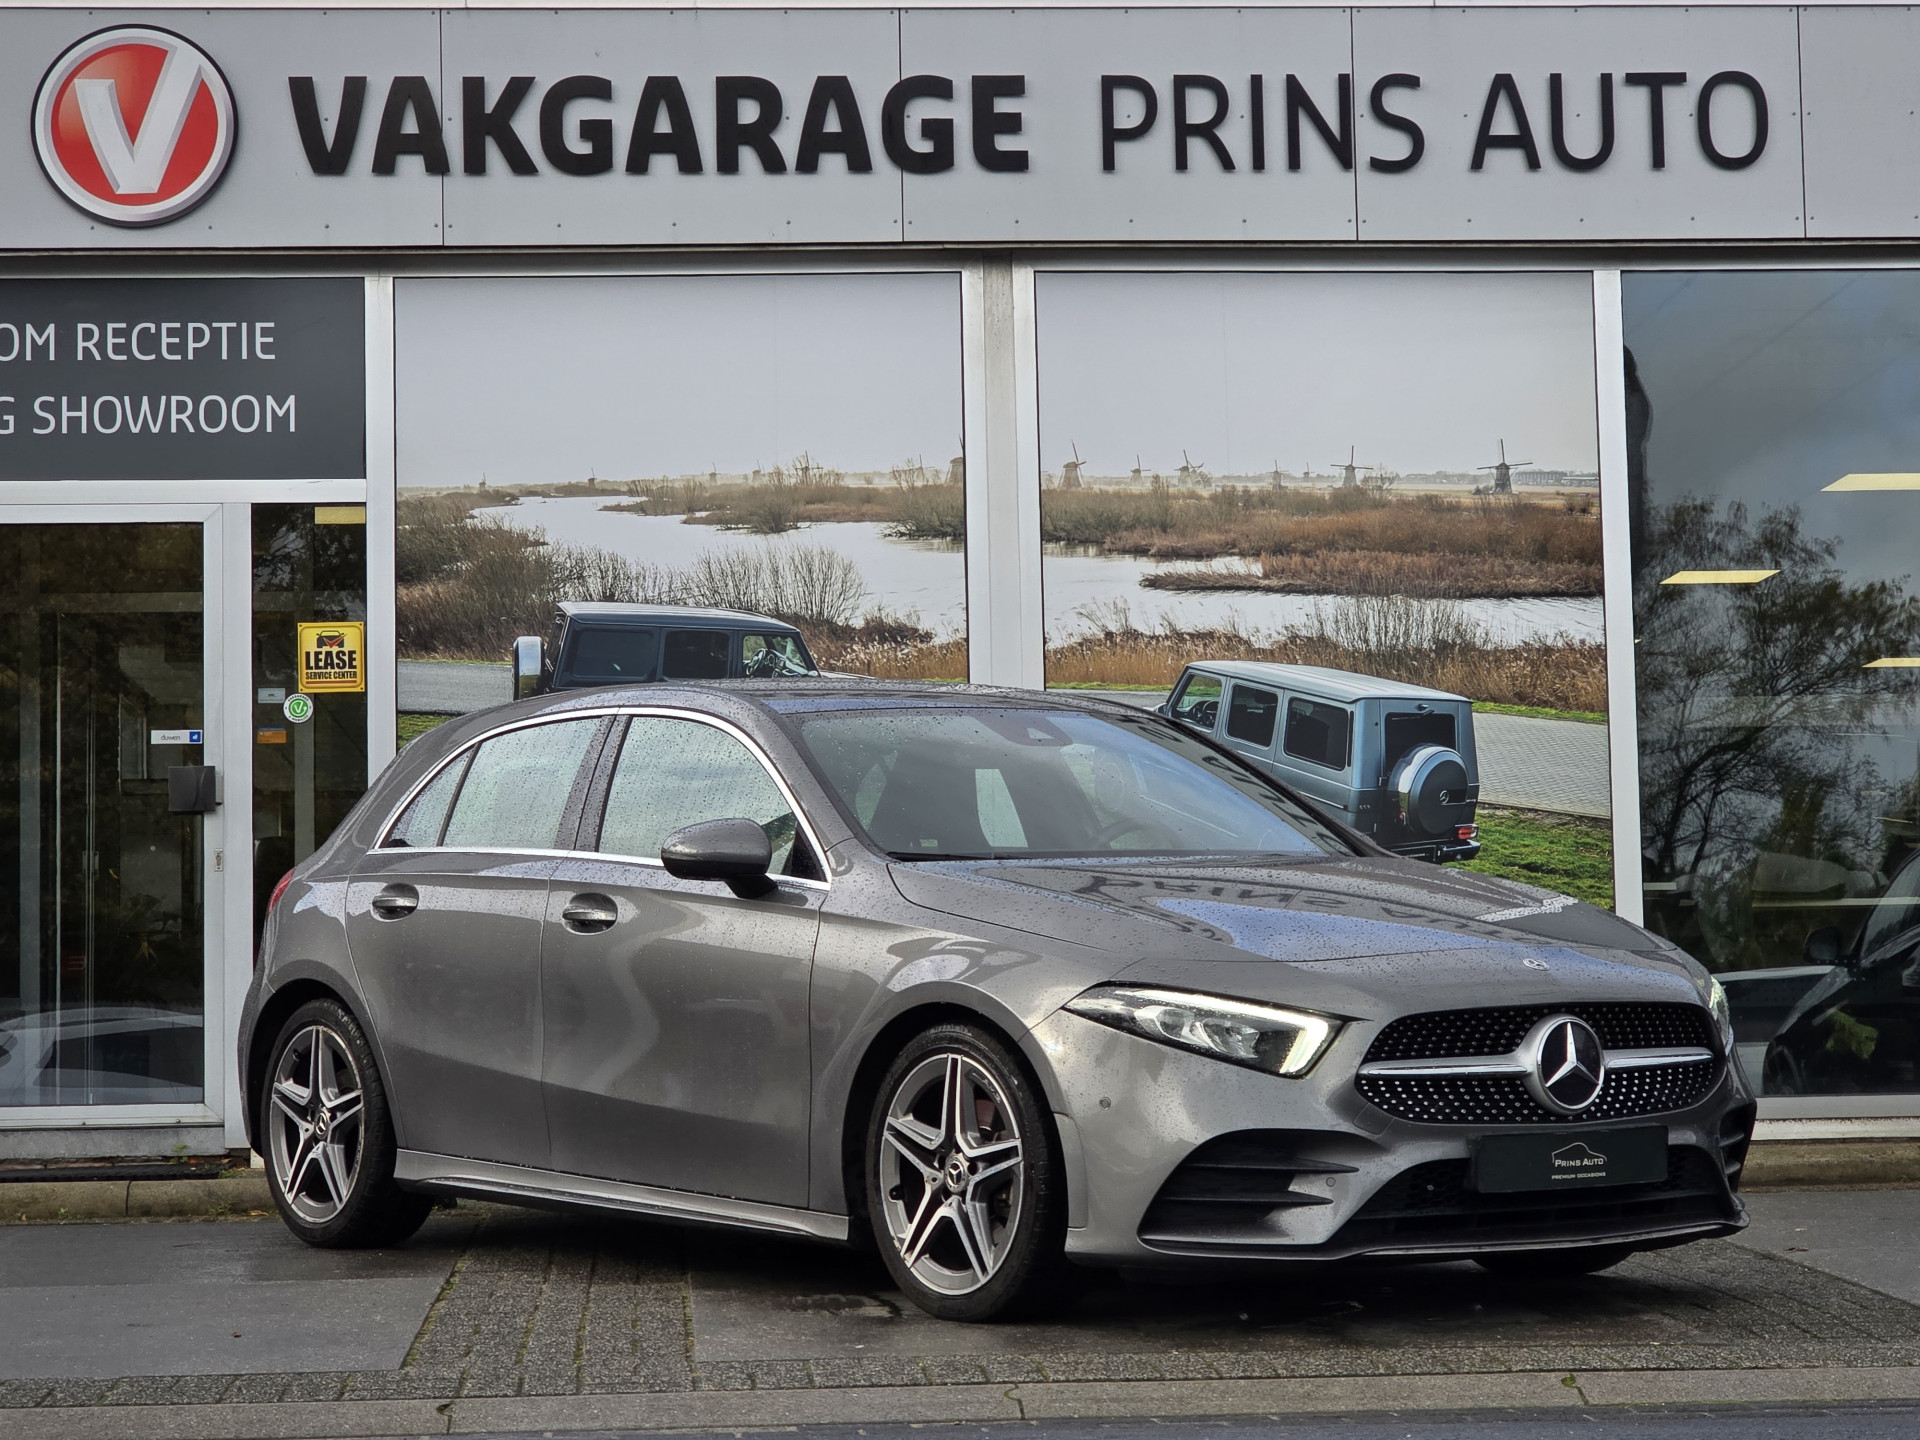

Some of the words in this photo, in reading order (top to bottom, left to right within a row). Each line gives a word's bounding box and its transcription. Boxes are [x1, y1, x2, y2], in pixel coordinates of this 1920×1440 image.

[288, 75, 1030, 177] VAKGARAGE
[1100, 73, 1426, 175] PRINS
[1470, 70, 1770, 174] AUTO
[77, 322, 276, 361] RECEPTIE
[33, 395, 296, 434] SHOWROOM
[305, 650, 357, 670] LEASE
[305, 671, 332, 680] SERVICE
[333, 671, 357, 679] CENTER
[1555, 1159, 1581, 1167] PRINS
[1582, 1158, 1604, 1166] AUTO
